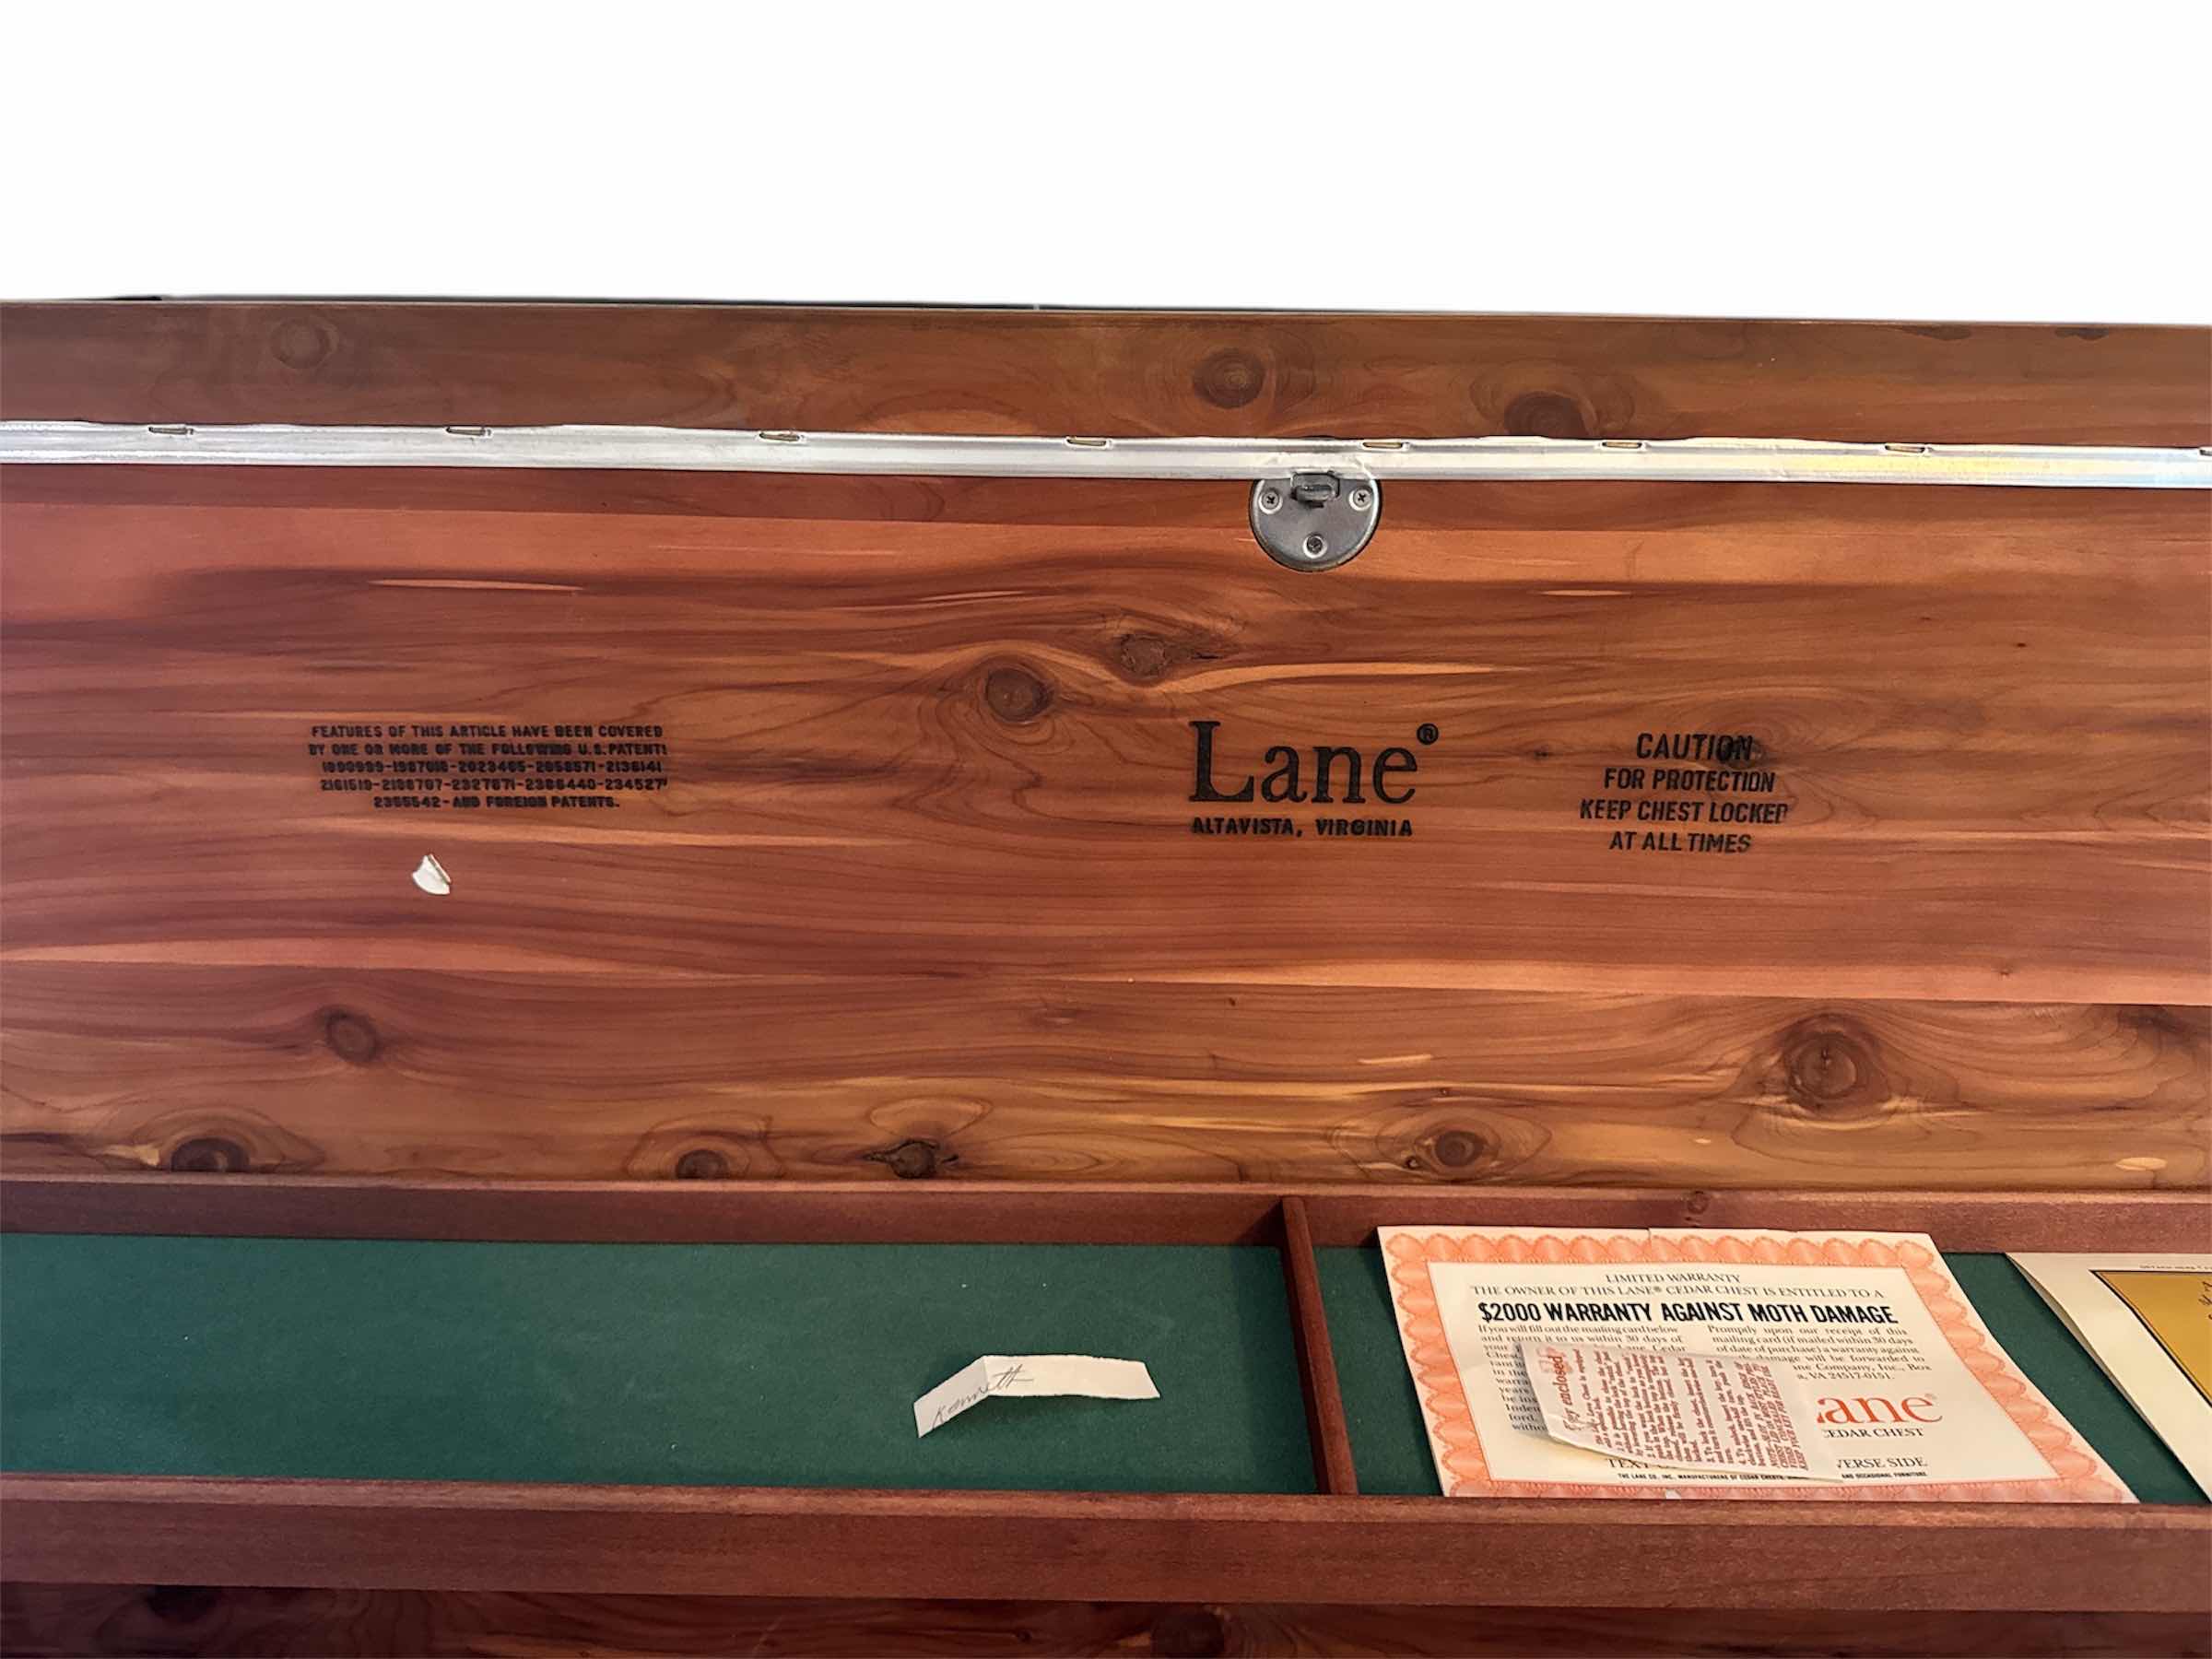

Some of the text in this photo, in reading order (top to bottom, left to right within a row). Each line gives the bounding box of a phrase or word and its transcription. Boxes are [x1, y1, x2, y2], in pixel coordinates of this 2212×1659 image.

[312, 725, 664, 737] FEATURES OF THIS ARTICLE HAVE BEEN COVERED
[309, 744, 325, 755] BY
[331, 744, 359, 755] ONE
[364, 744, 383, 755] OR
[389, 744, 428, 755] MORE
[435, 744, 452, 755] OF
[458, 744, 486, 755] THE
[491, 743, 572, 755] FOLLOWING
[1636, 733, 1753, 761] CAUTION
[1604, 768, 1775, 793] FOR PROTECTION
[487, 795, 547, 807] FOREIGN
[551, 795, 620, 807] PATENTS.
[1580, 798, 1631, 820] KEEP
[1637, 800, 1704, 822] CHEST
[1192, 817, 1412, 837] ALTAVISTA, VIRGINIA
[1609, 831, 1752, 853] AT ALL TIMES
[1606, 1274, 1741, 1283] LIMITED WARRANTY
[1471, 1286, 1500, 1295] THE
[1504, 1286, 1557, 1295] OWNER
[1558, 1286, 1578, 1295] OF
[1581, 1286, 1615, 1295] THIS
[1665, 1286, 1713, 1295] CEDAR
[1714, 1286, 1759, 1296] CHEST
[1761, 1288, 1776, 1296] IS
[1778, 1288, 1846, 1298] ENTITLED
[1846, 1288, 1870, 1299] TO
[1873, 1289, 1885, 1299] A
[1478, 1301, 1899, 1324] $2000 WARRANTY AGAINST MOTH DAMAGE
[1488, 1327, 1509, 1335] you
[1509, 1325, 1528, 1334] will
[1582, 1326, 1621, 1335] mailing
[1646, 1325, 1678, 1334] below
[1707, 1325, 1757, 1335] Promptly
[1763, 1327, 1793, 1336] upon
[1825, 1327, 1862, 1336] receipt
[1642, 1335, 1666, 1344] days
[1712, 1335, 1756, 1345] mailing
[1888, 1336, 1913, 1346] days
[1829, 1347, 1877, 1355] warranty
[1879, 1347, 1920, 1355] against
[1805, 1354, 1826, 1362] will
[1850, 1355, 1909, 1363] forwarded
[1907, 1363, 1932, 1371] Box
[1548, 1356, 1572, 1406] enclosed
[1872, 1428, 1924, 1438] CHEST
[1887, 1456, 1927, 1467] SIDE
